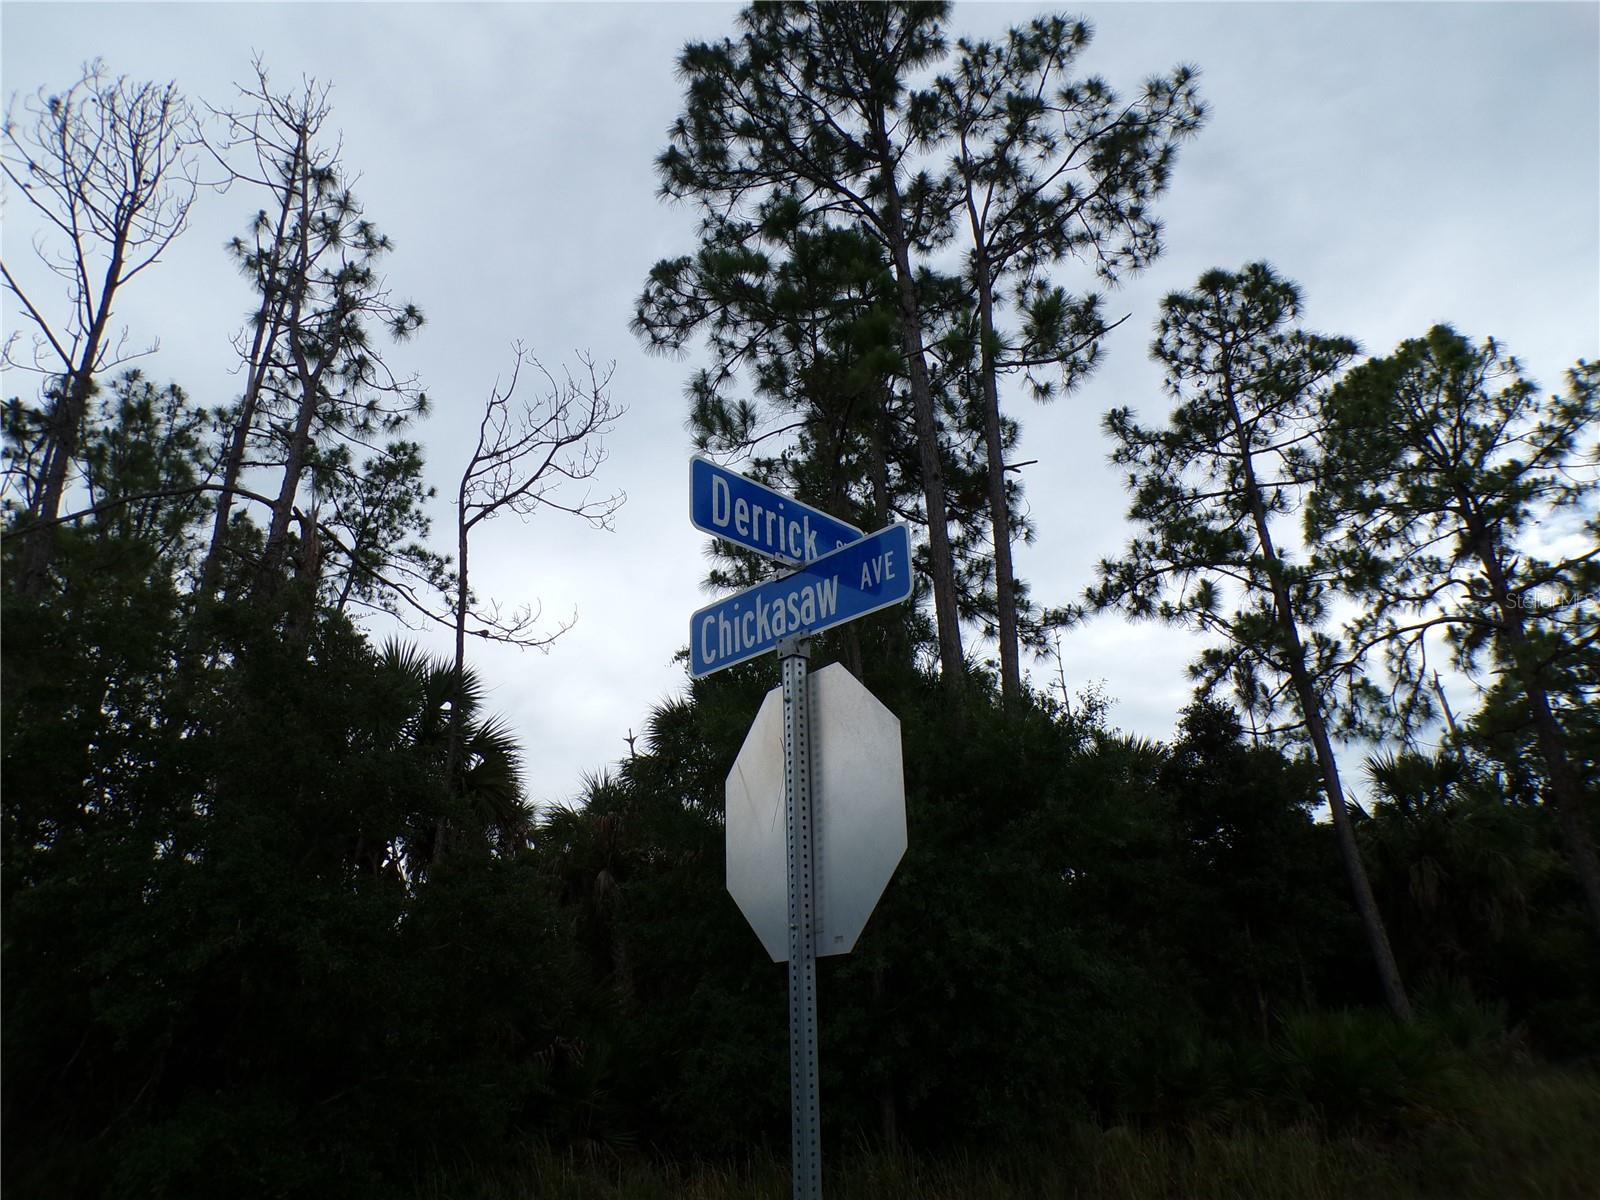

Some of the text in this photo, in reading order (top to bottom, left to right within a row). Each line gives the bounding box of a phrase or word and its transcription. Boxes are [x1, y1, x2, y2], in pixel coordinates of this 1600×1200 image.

[712, 474, 818, 561] Derrick
[701, 551, 895, 665] Chickasaw AVE
